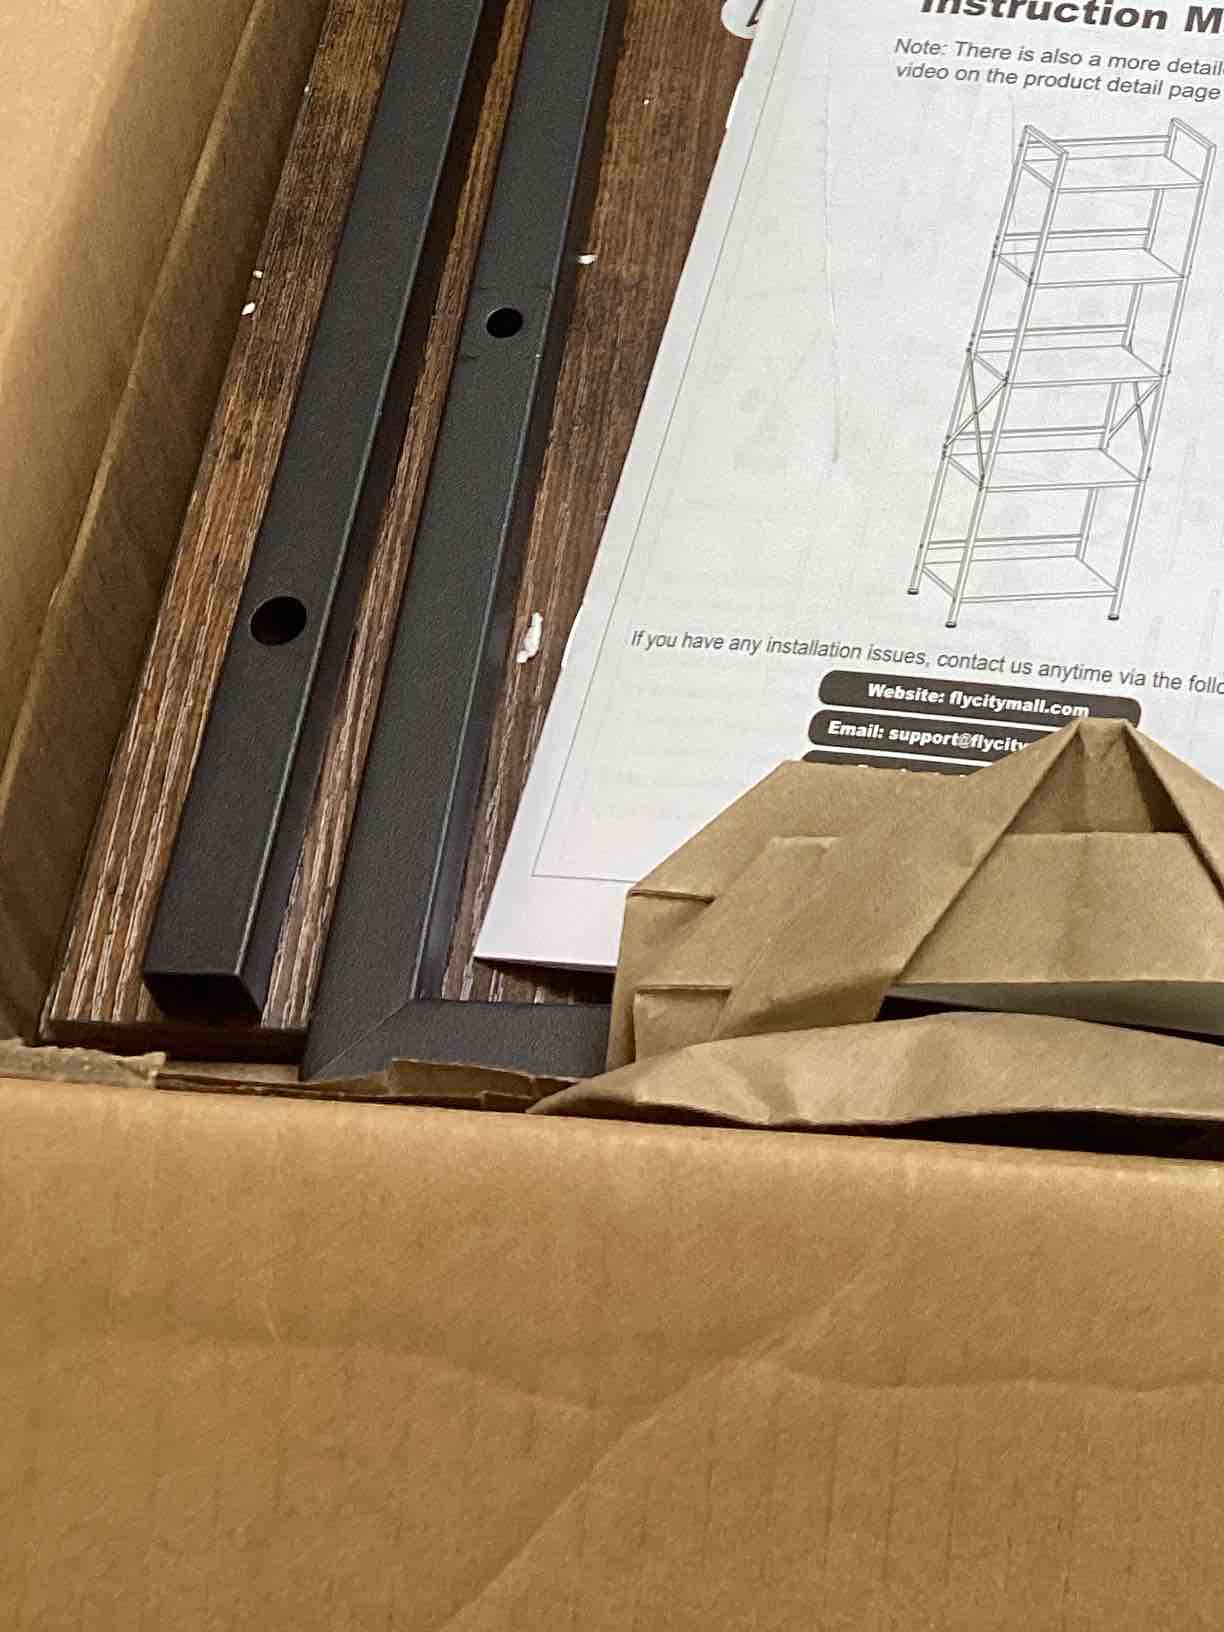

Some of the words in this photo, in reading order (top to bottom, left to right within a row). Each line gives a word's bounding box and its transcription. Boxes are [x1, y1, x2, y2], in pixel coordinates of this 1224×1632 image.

[894, 38, 948, 56] Note:
[955, 40, 1012, 61] There
[1017, 45, 1035, 62] is
[1040, 48, 1083, 65] also
[1088, 54, 1102, 67] a
[1107, 56, 1161, 72] more
[896, 62, 950, 80] video
[954, 68, 980, 82] on
[986, 67, 1018, 85] the
[1022, 72, 1102, 91] product
[1106, 76, 1164, 96] detail
[1167, 85, 1222, 103] page
[631, 629, 645, 647] If
[646, 633, 679, 653] you
[681, 631, 726, 650] have
[728, 637, 764, 657] any
[766, 637, 862, 661] installation
[867, 641, 931, 668] issues,
[937, 652, 1006, 673] contact
[1011, 660, 1033, 676] us
[1039, 662, 1113, 685] anytime
[1118, 670, 1147, 687] via
[1152, 672, 1183, 691] the
[868, 683, 945, 704] Website:
[949, 690, 1089, 719] flycitymall.com
[827, 720, 885, 740] Email:
